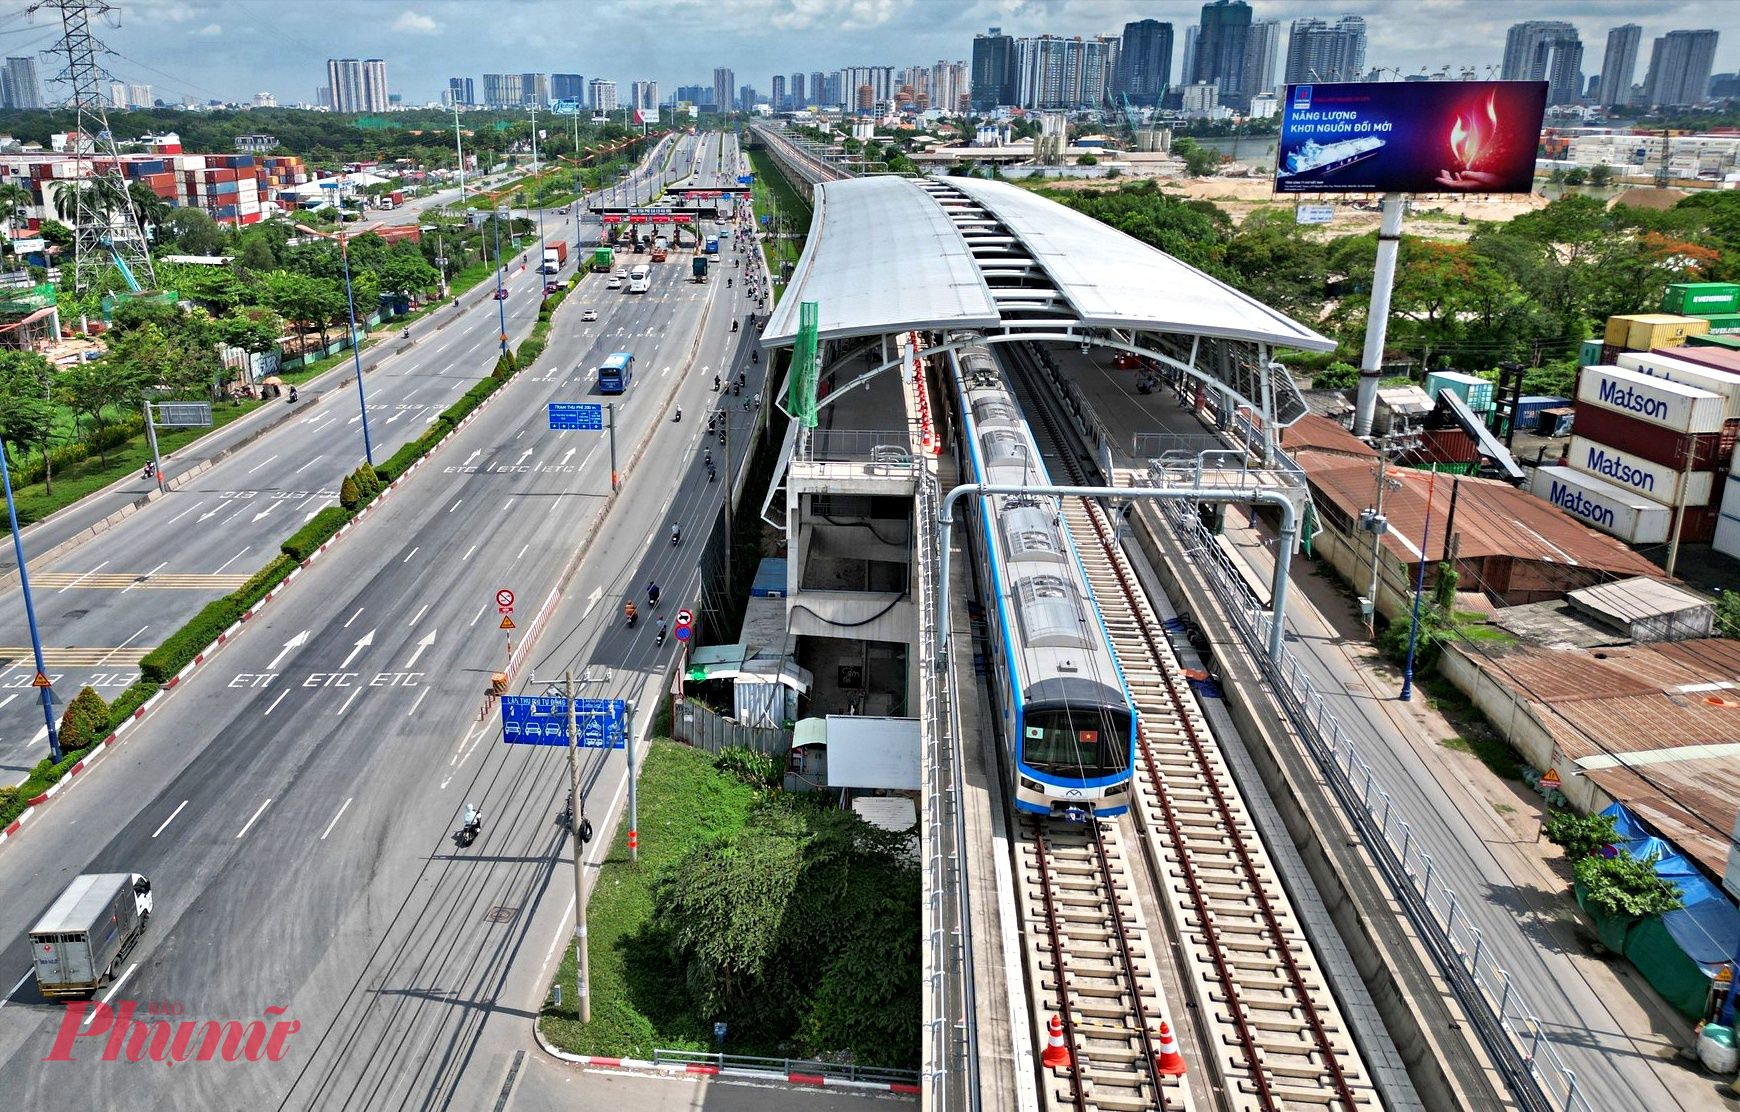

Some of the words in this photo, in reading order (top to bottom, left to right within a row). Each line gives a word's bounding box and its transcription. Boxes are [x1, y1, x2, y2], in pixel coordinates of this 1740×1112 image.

[1292, 111, 1320, 120] NĂNG
[1322, 111, 1357, 121] LƯỢNG
[1599, 378, 1668, 420] Matson
[1587, 447, 1654, 492] Matson
[1550, 481, 1614, 528] Matson
[302, 672, 358, 687] ETC
[369, 672, 424, 687] ETC
